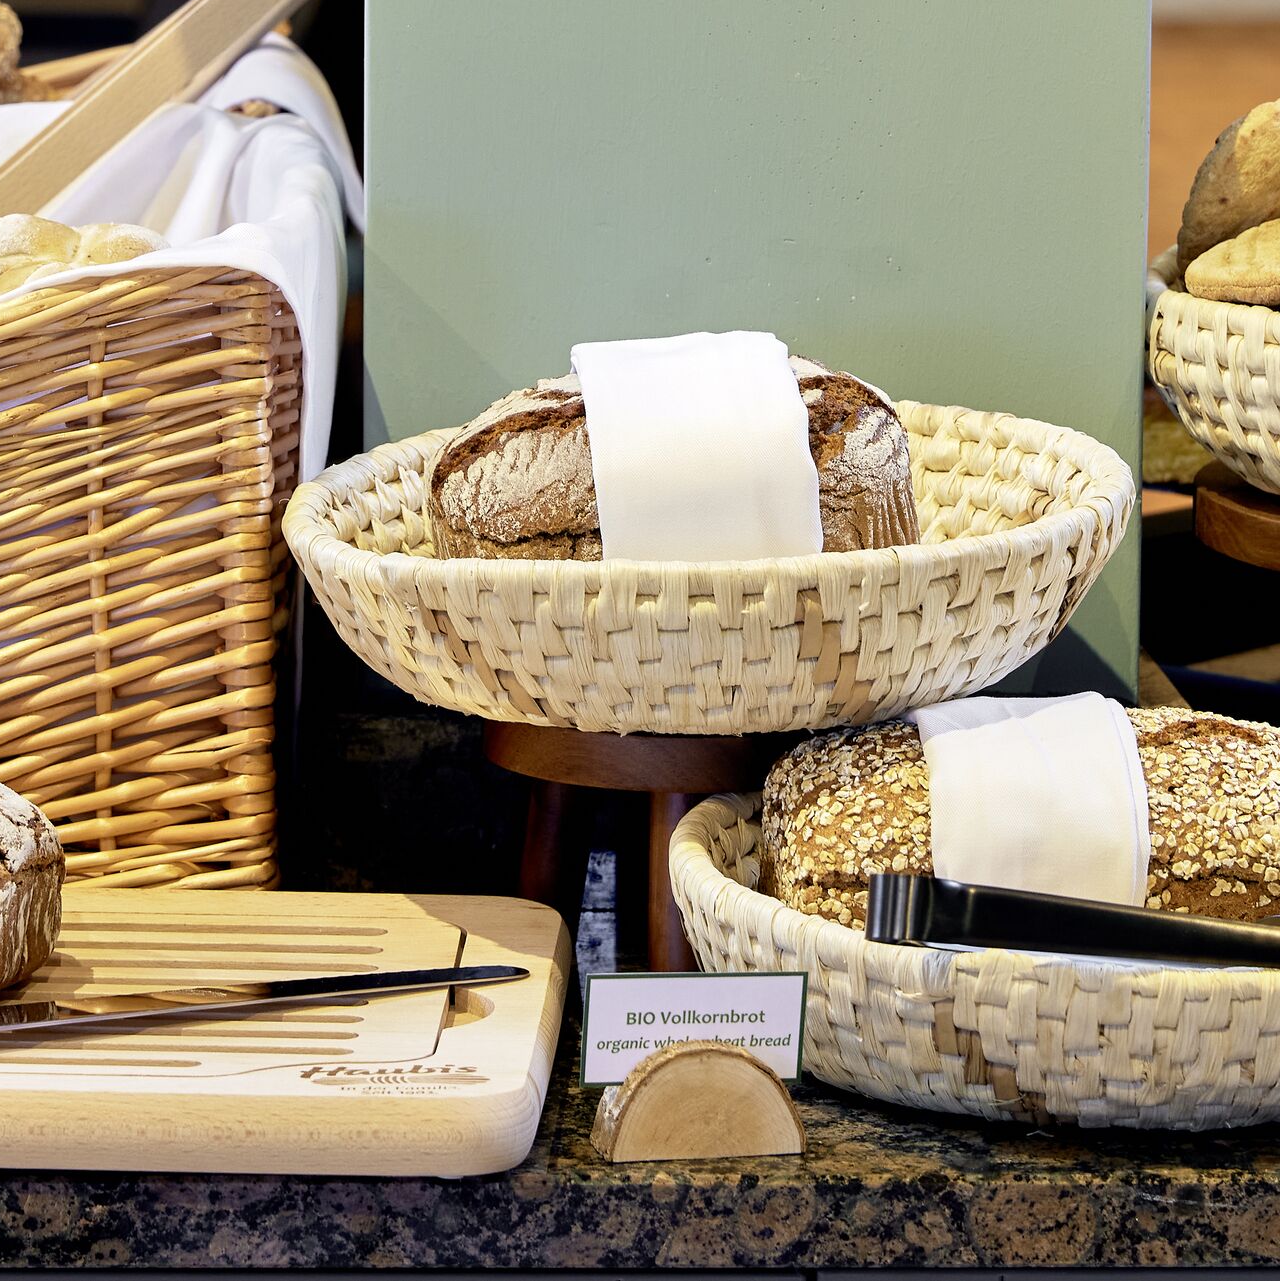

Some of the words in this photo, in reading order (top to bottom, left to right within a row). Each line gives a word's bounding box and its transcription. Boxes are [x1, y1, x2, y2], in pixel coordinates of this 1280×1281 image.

[626, 1011, 656, 1025] BIO
[661, 1010, 766, 1025] Vollkornbrot
[597, 1036, 650, 1053] organic
[749, 1033, 792, 1047] bread
[300, 1064, 478, 1078] Haubis
